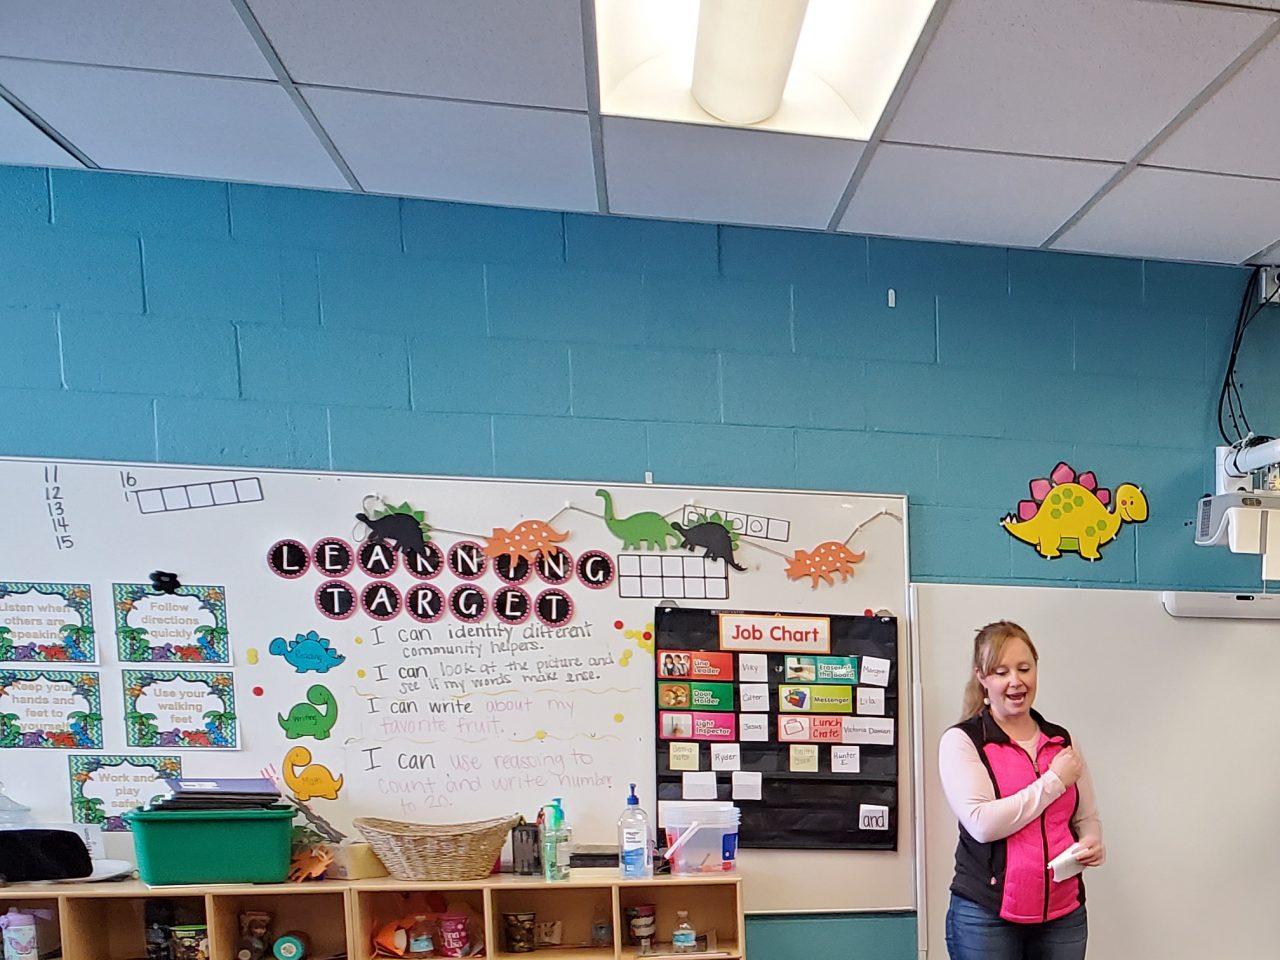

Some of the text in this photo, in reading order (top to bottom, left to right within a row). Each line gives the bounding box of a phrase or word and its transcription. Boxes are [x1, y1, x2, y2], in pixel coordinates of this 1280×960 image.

[45, 465, 58, 483] 11
[120, 470, 137, 488] 16
[45, 486, 64, 500] 12
[48, 502, 65, 517] 13
[52, 516, 69, 533] 14
[56, 535, 74, 550] 15
[281, 544, 607, 583] LEARNING
[0, 601, 71, 613] Listen when
[150, 601, 189, 612] Follow
[325, 585, 565, 621] TARGET
[4, 615, 66, 626] others are
[141, 614, 199, 626] directions
[10, 629, 65, 643] speaking
[150, 629, 193, 640] quickly
[371, 620, 593, 646] I can identify different
[731, 624, 820, 643] Job Chart
[402, 638, 545, 659] community helpers.
[373, 652, 615, 682] I can look at the picture and
[742, 664, 759, 674] Viky
[12, 681, 73, 694] Keep your
[400, 670, 557, 694] see if my words make
[12, 695, 76, 706] hands and
[153, 688, 206, 702] Use your
[25, 708, 64, 718] feet to
[158, 701, 204, 713] walking
[367, 696, 575, 719] I can write about my
[170, 715, 193, 724] feet
[293, 714, 317, 726] Writing
[382, 716, 505, 735] favorite fruit.
[696, 720, 714, 728] Light
[812, 717, 842, 727] Lunch
[20, 721, 70, 733] yourself
[696, 727, 730, 736] Inspector
[843, 725, 867, 734] Victoria
[812, 729, 840, 738] Crate
[361, 746, 383, 771] I
[397, 752, 436, 771] can
[449, 755, 483, 771] use
[570, 750, 594, 766] to
[715, 753, 737, 763] Ryder
[833, 752, 857, 760] Hunter
[98, 772, 156, 784] Work and
[377, 777, 437, 795] count
[446, 777, 482, 793] and
[492, 773, 547, 792] write
[115, 786, 140, 798] play
[111, 799, 146, 809] safely
[400, 795, 454, 816] to 20.
[862, 812, 885, 829] and
